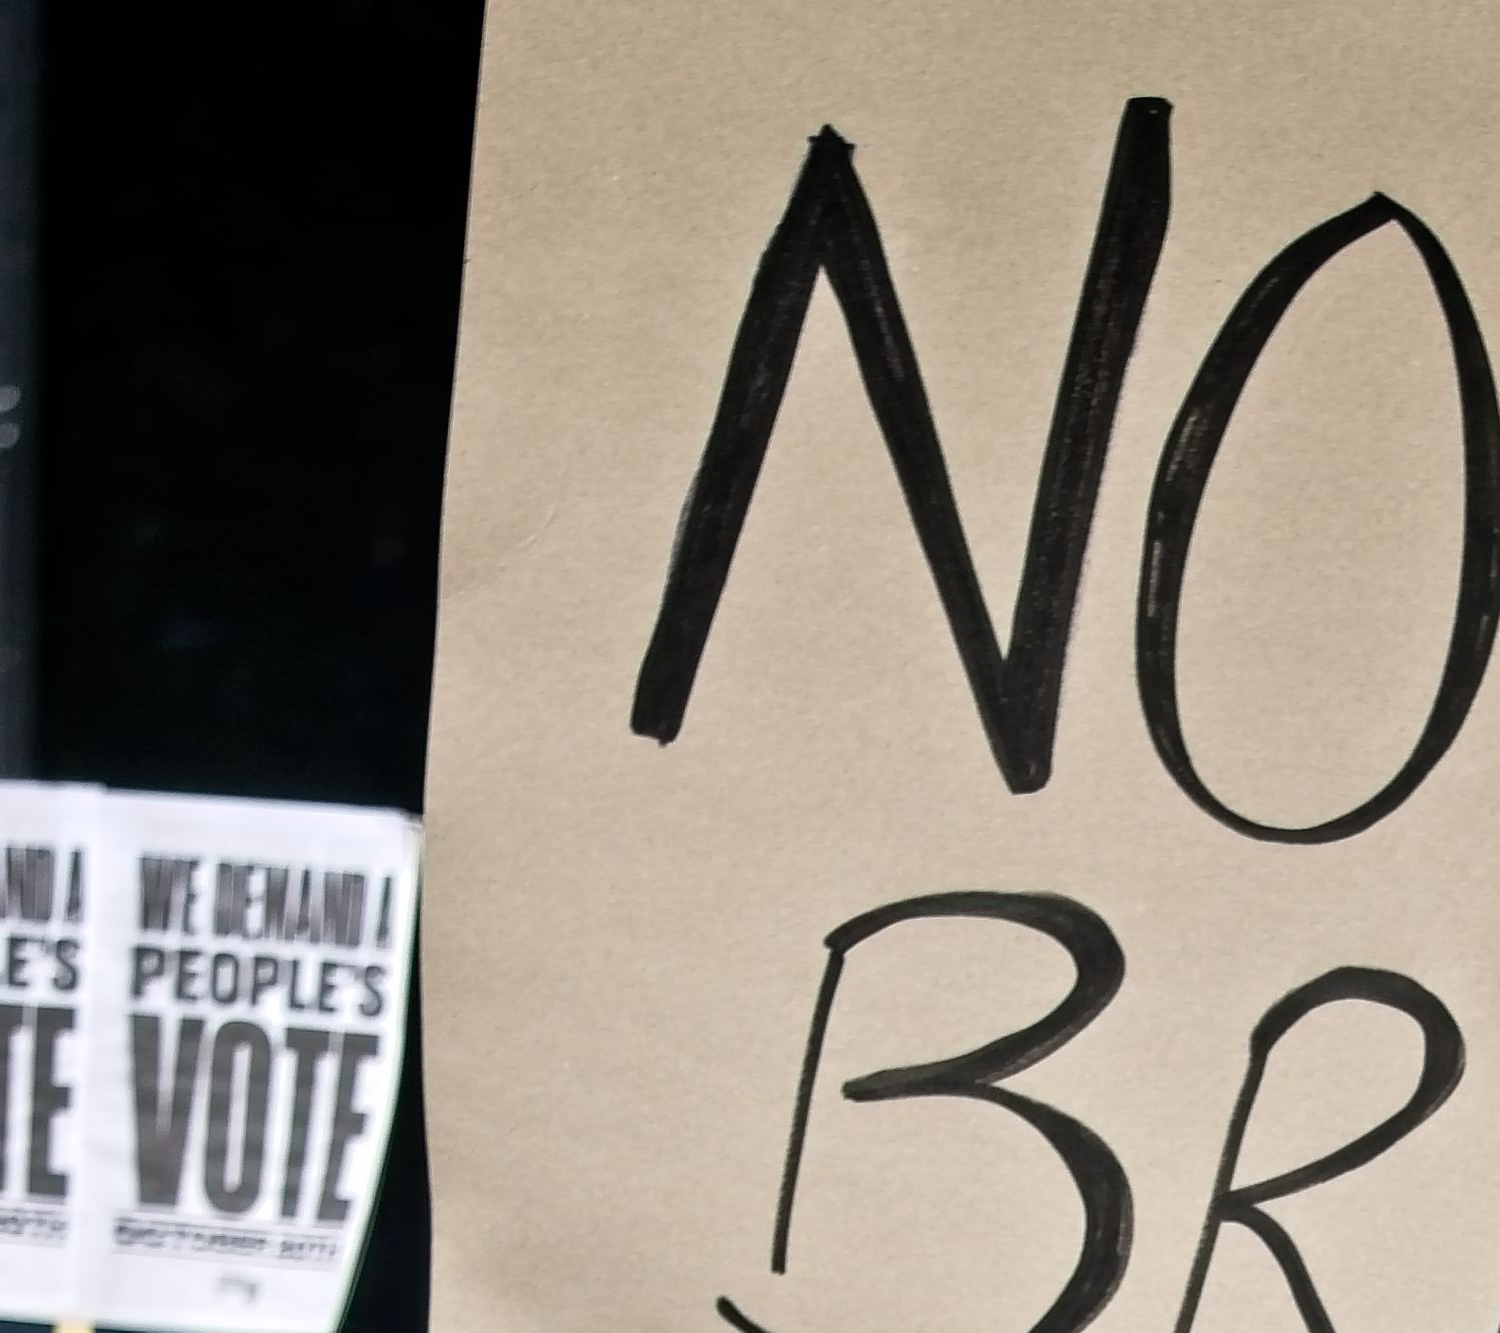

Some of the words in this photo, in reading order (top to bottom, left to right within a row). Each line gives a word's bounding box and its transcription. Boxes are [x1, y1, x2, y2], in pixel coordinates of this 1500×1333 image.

[138, 855, 198, 935] WE
[131, 944, 389, 1020] PEOPLE'S
[128, 1011, 380, 1224] VOTE
